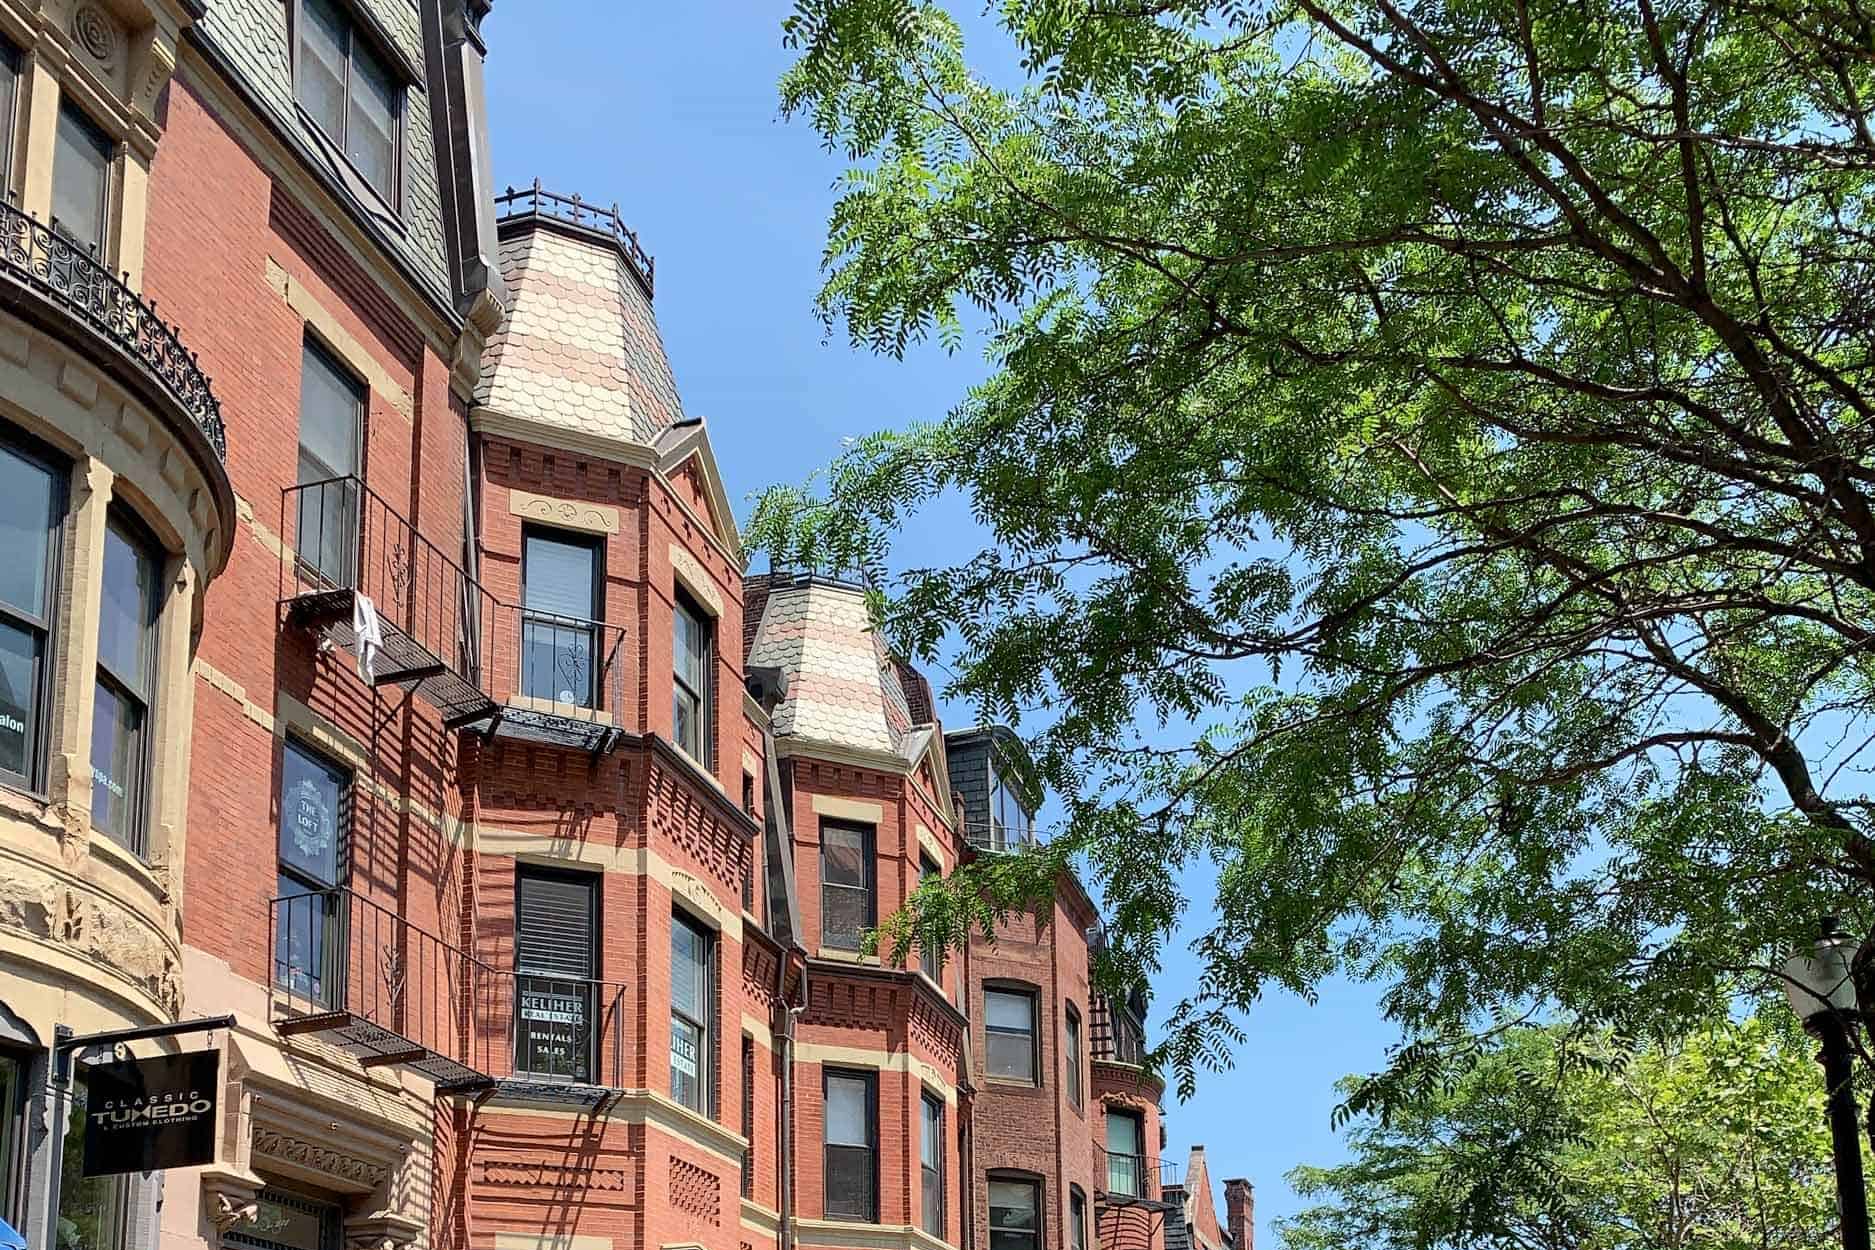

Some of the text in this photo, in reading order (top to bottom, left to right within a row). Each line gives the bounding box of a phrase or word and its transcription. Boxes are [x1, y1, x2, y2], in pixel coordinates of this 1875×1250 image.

[298, 814, 318, 832] LOFT
[521, 997, 583, 1013] KELIHER
[530, 1032, 573, 1044] RENTALS
[537, 1045, 566, 1056] SALES
[105, 1091, 199, 1109] CLASSIC
[91, 1100, 212, 1125] TUXEDO
